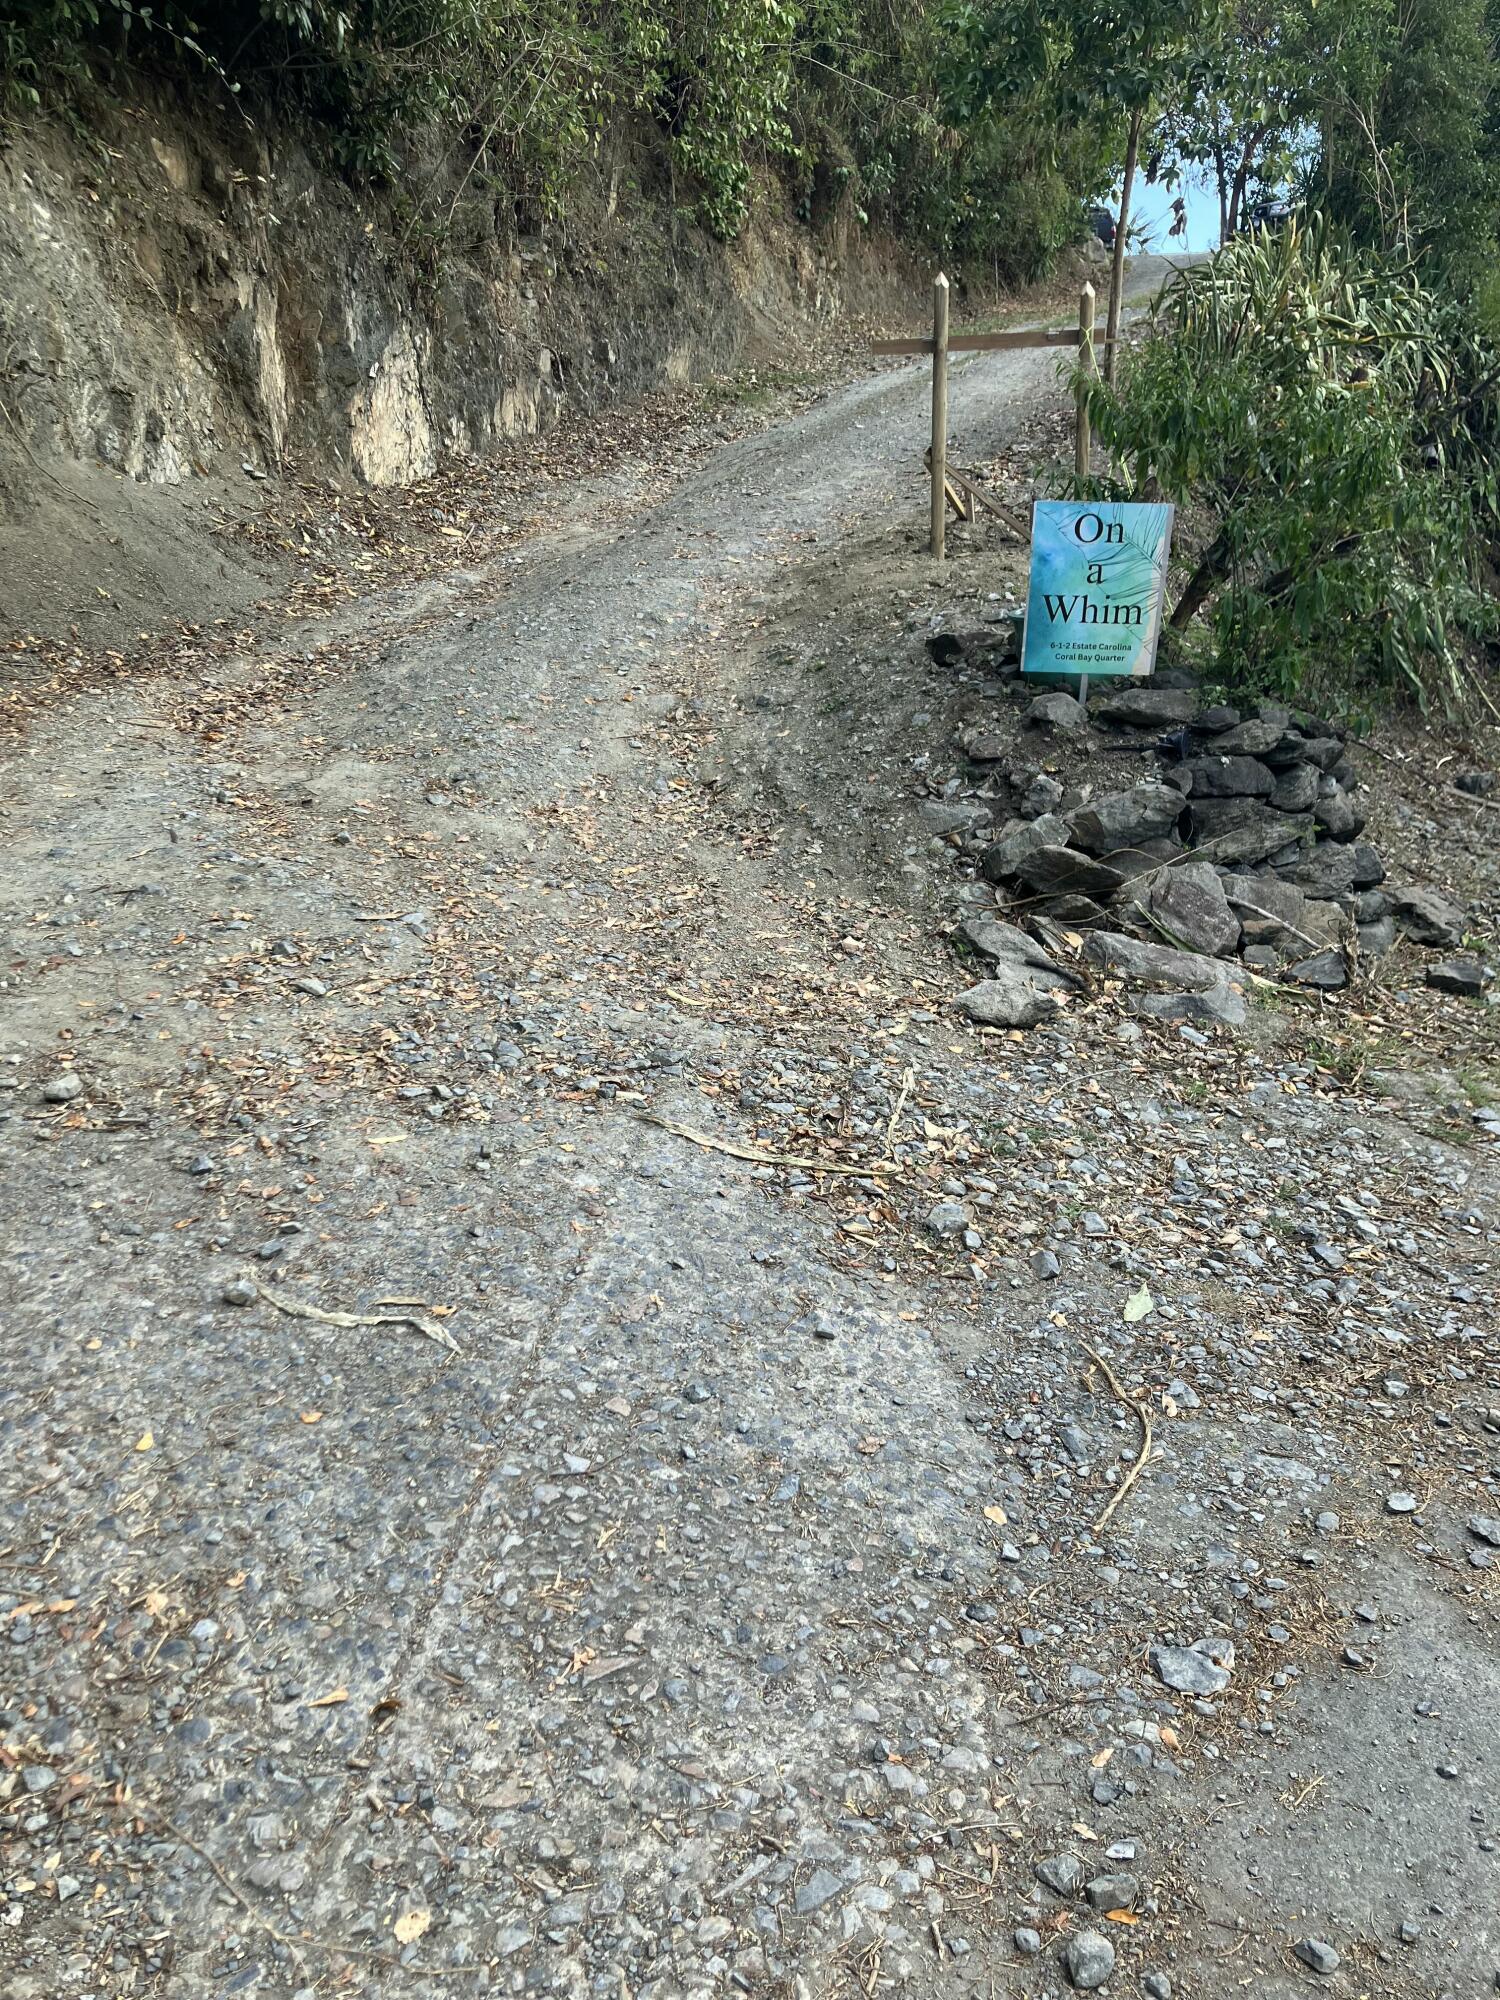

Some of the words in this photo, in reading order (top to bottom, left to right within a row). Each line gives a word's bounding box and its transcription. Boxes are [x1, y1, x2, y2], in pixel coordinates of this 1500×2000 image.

[1074, 513, 1125, 543] On
[1086, 563, 1104, 584] a
[1043, 594, 1143, 625] Whim
[1072, 642, 1097, 650] Estate
[1098, 643, 1132, 651] Carolina
[1077, 653, 1093, 662] Bay
[1094, 654, 1126, 662] Quarter
